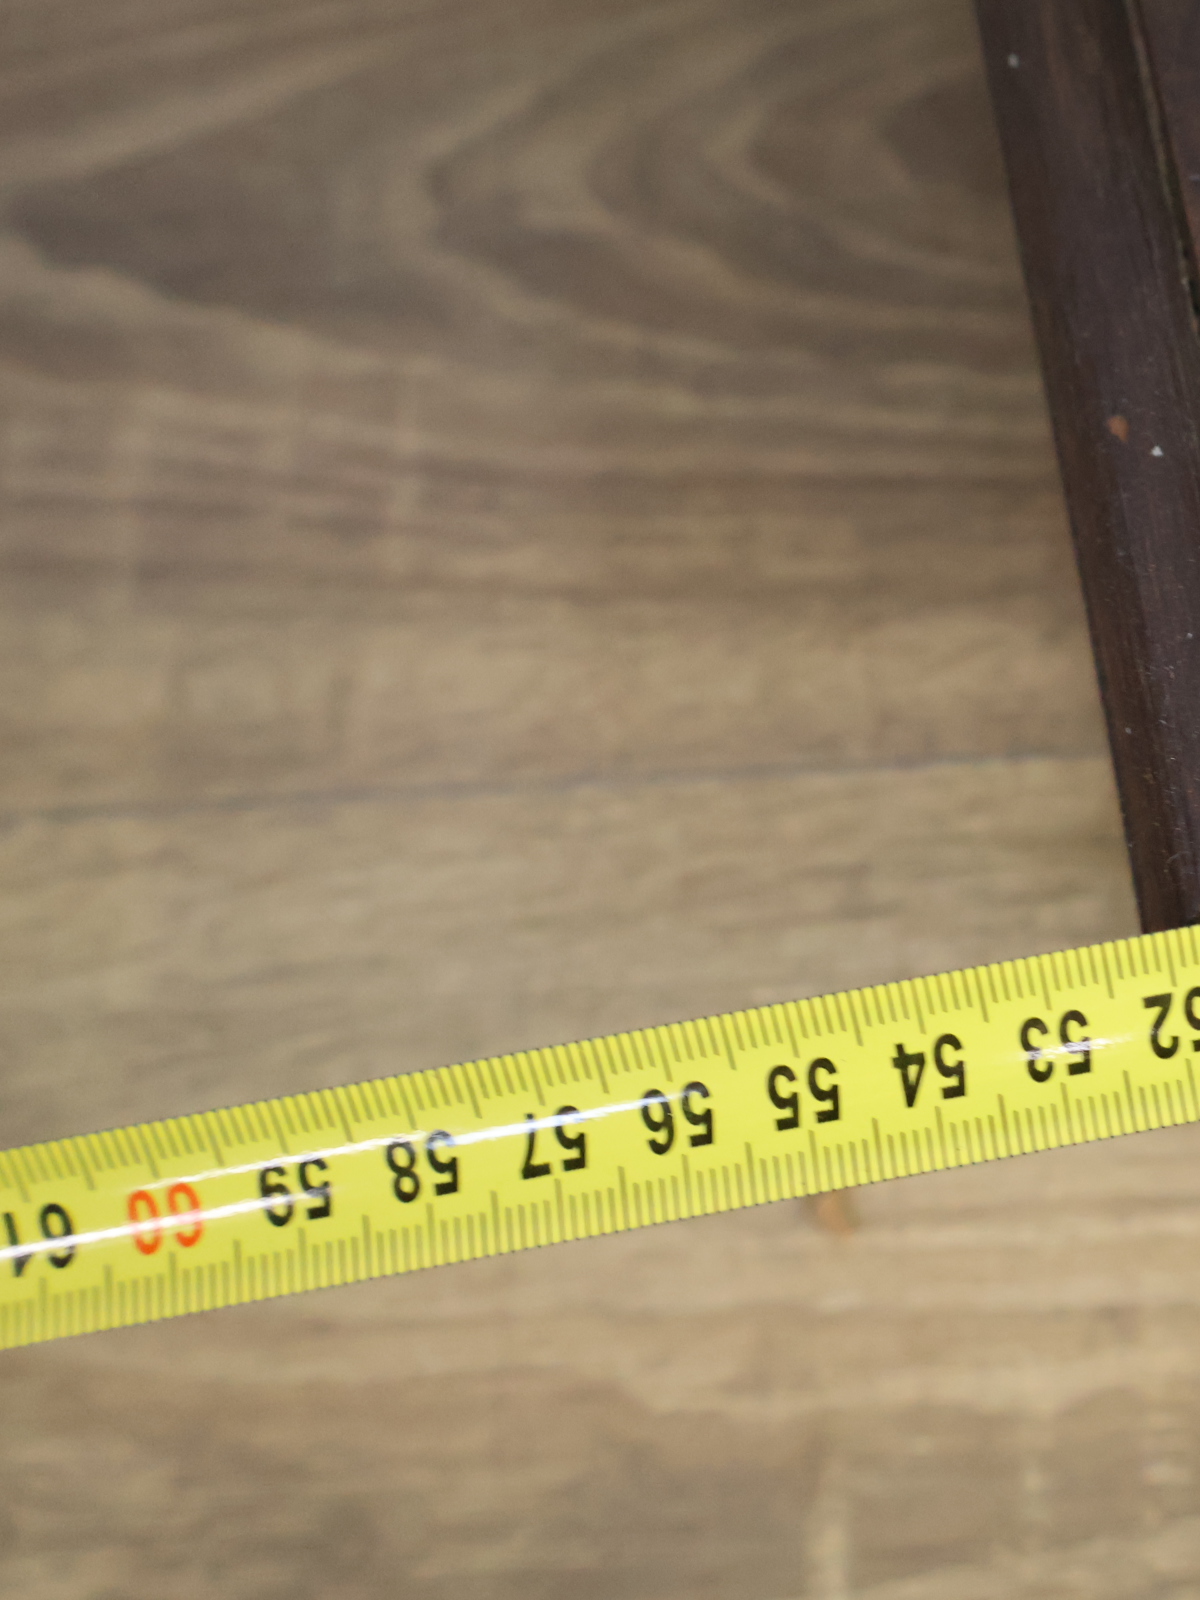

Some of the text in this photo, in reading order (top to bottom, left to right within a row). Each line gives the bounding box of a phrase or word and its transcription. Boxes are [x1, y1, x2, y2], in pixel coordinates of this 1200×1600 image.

[891, 1034, 966, 1108] 54
[1020, 1010, 1093, 1083] 53
[641, 1081, 714, 1155] 56
[767, 1058, 841, 1131] 55
[386, 1130, 459, 1203] 58
[520, 1105, 587, 1180] 57
[127, 1183, 204, 1255] 60
[259, 1155, 333, 1227] 59
[3, 1203, 75, 1277] 61
